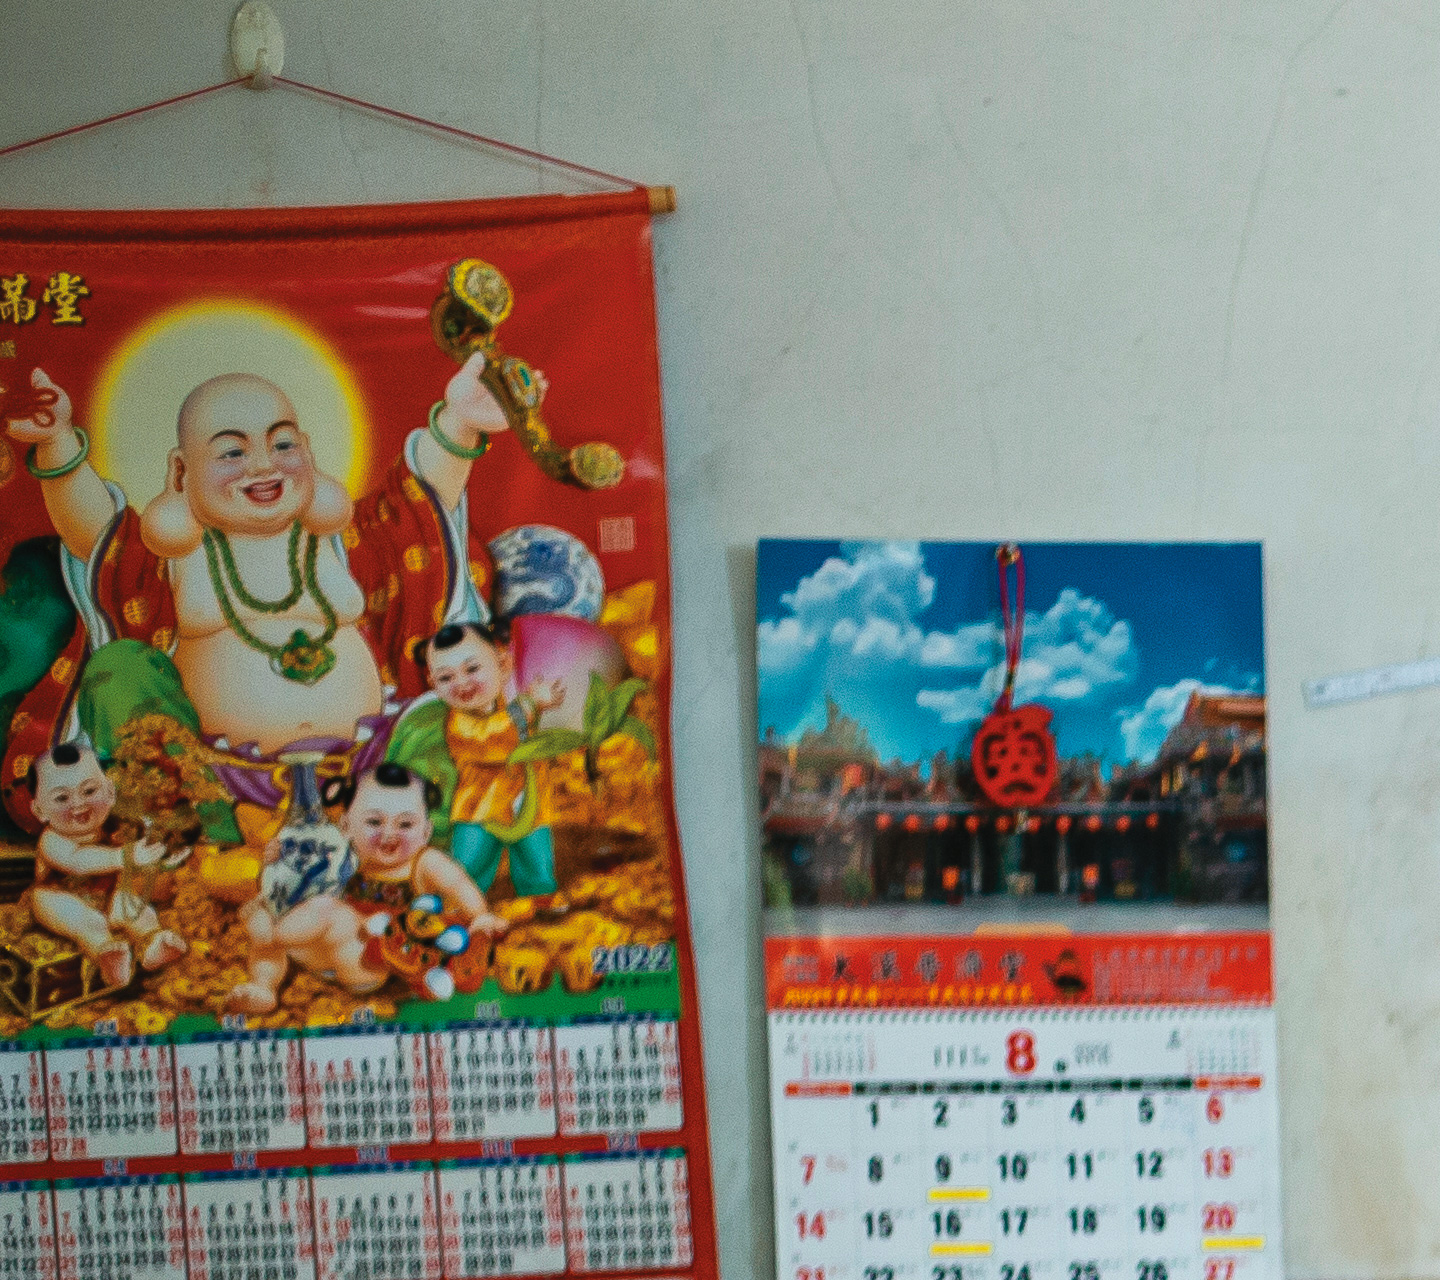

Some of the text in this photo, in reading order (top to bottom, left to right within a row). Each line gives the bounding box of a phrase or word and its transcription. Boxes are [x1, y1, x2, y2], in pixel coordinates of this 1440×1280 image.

[1005, 1028, 1038, 1075] 8
[867, 1095, 1224, 1129] 1 2 3 4 5 6
[802, 1146, 1234, 1185] 7 8 9 10 11 12 13
[796, 1202, 1236, 1240] 14 15 16 17 18 19 20
